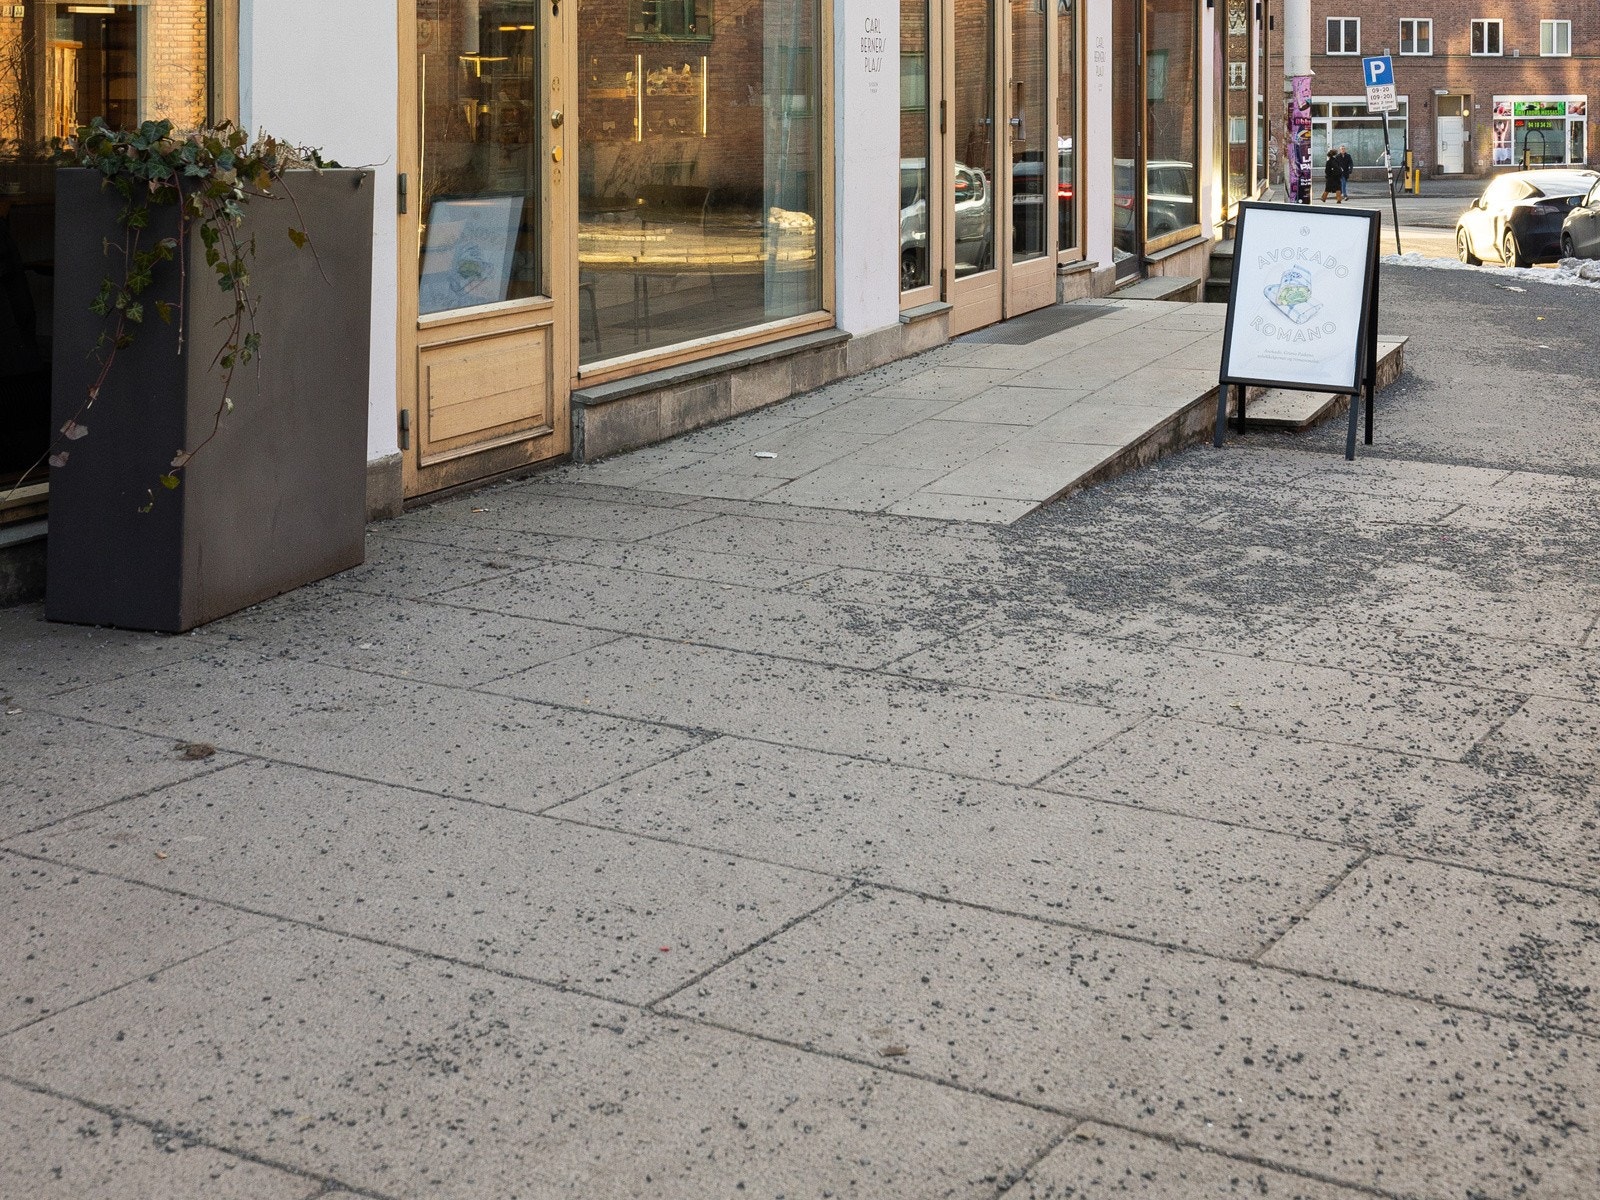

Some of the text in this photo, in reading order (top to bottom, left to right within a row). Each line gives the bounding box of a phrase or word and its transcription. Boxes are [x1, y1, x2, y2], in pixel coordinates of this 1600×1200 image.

[1370, 61, 1385, 82] P
[1257, 247, 1349, 279] AVOKADO
[1250, 315, 1337, 343] ROMANO
